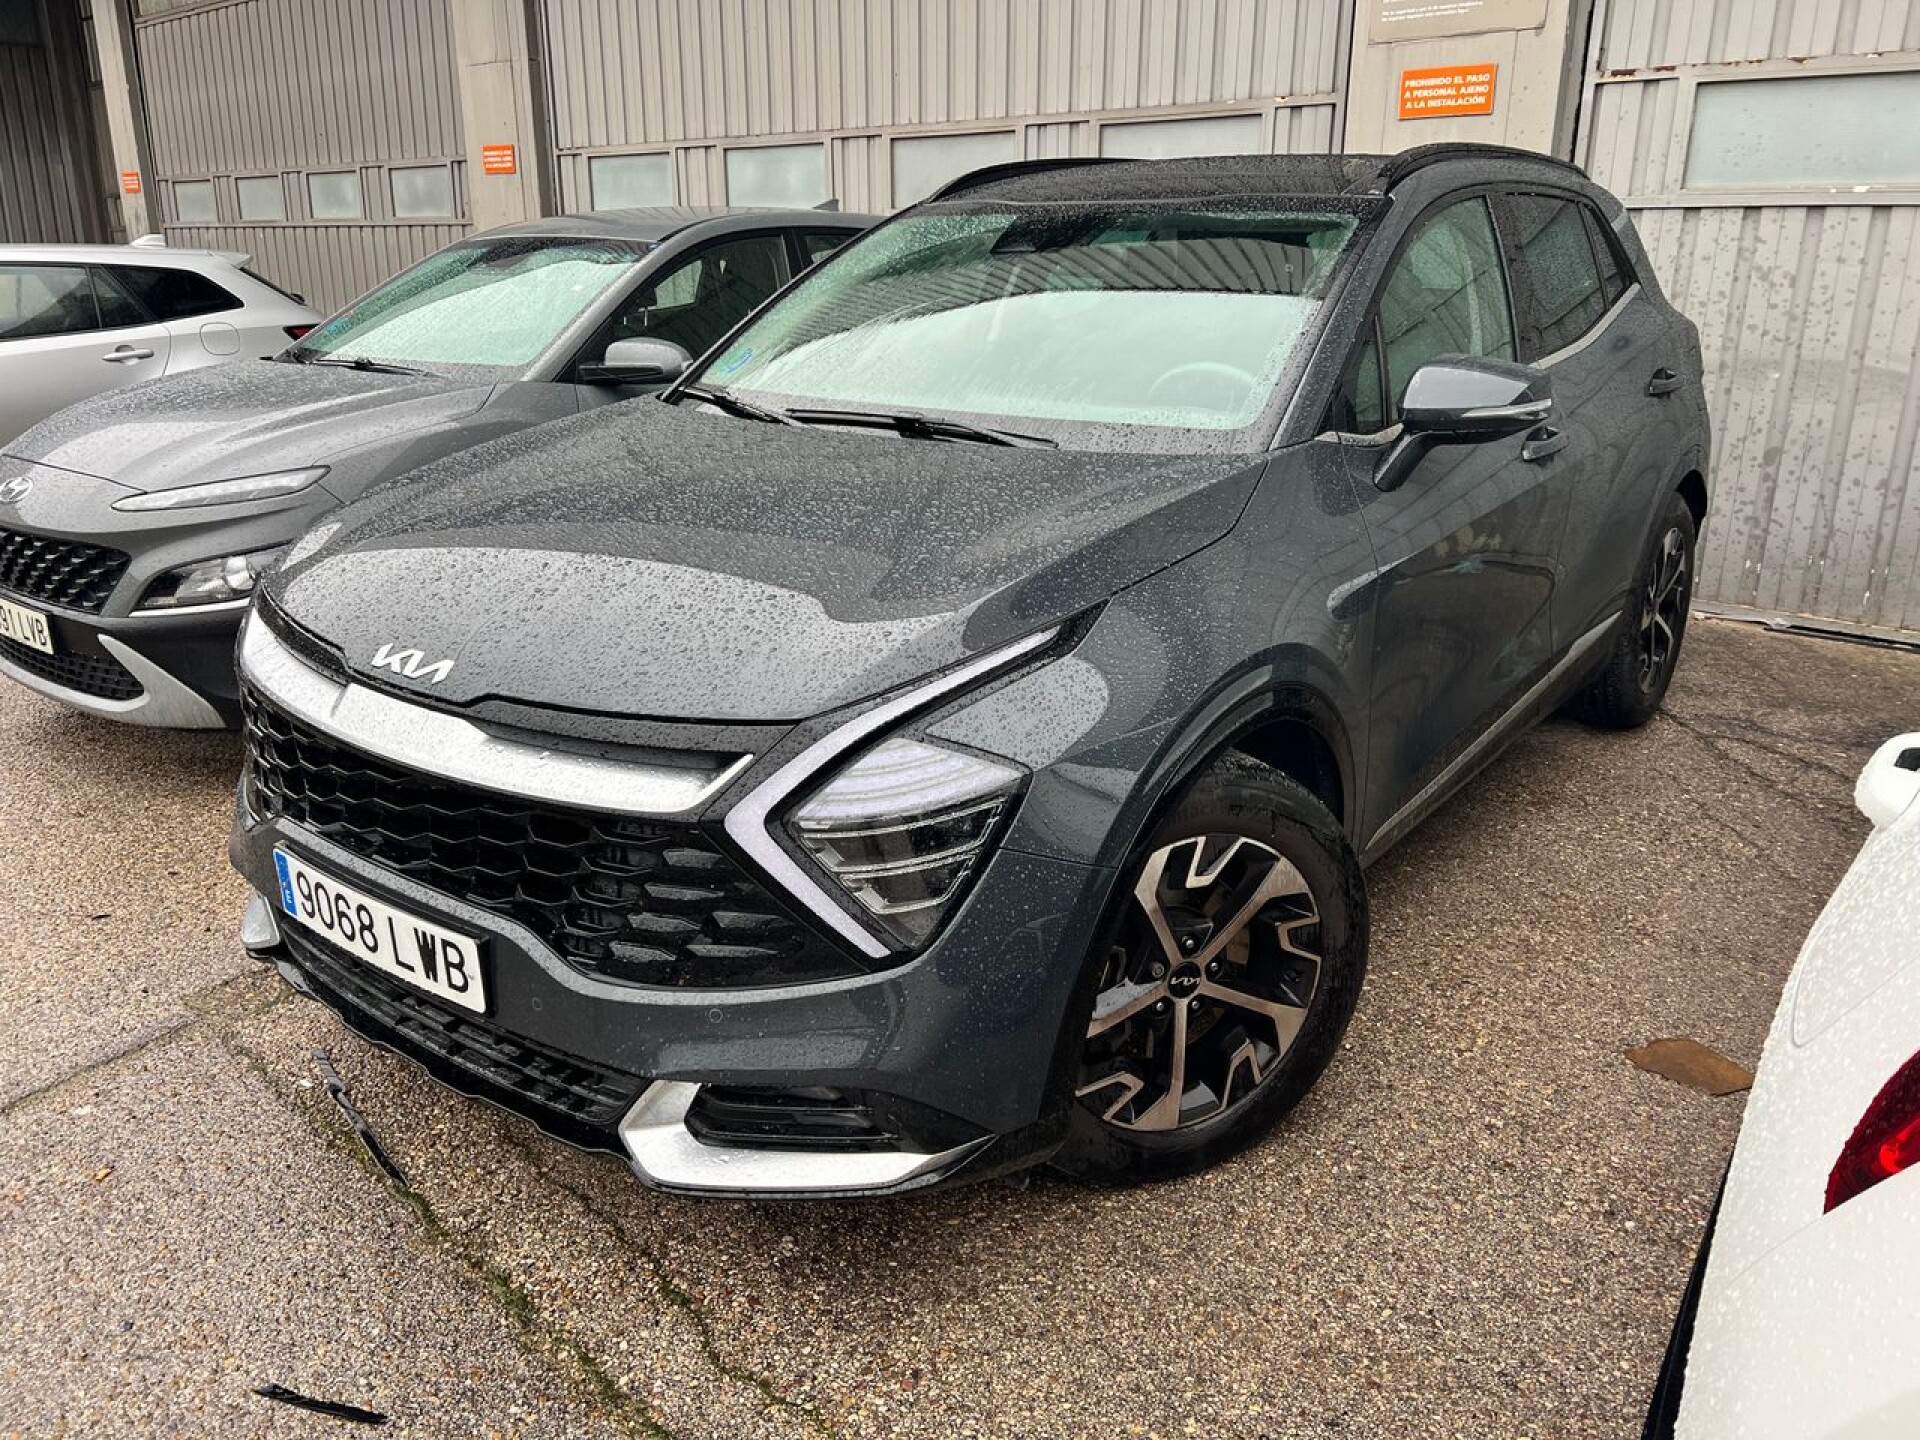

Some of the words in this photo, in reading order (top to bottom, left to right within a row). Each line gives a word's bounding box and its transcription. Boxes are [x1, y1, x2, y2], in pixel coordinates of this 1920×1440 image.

[1404, 77, 1452, 88] PROHIBIDO
[1453, 75, 1464, 84] EL
[1466, 73, 1490, 83] PASO
[1404, 91, 1411, 99] A
[1412, 86, 1457, 98] PERSONAL
[1460, 85, 1489, 94] AJENO
[1405, 101, 1412, 109] A
[1414, 101, 1425, 109] LA
[17, 612, 47, 646] LVB
[296, 870, 379, 954] 9068
[388, 916, 469, 993] LWB
